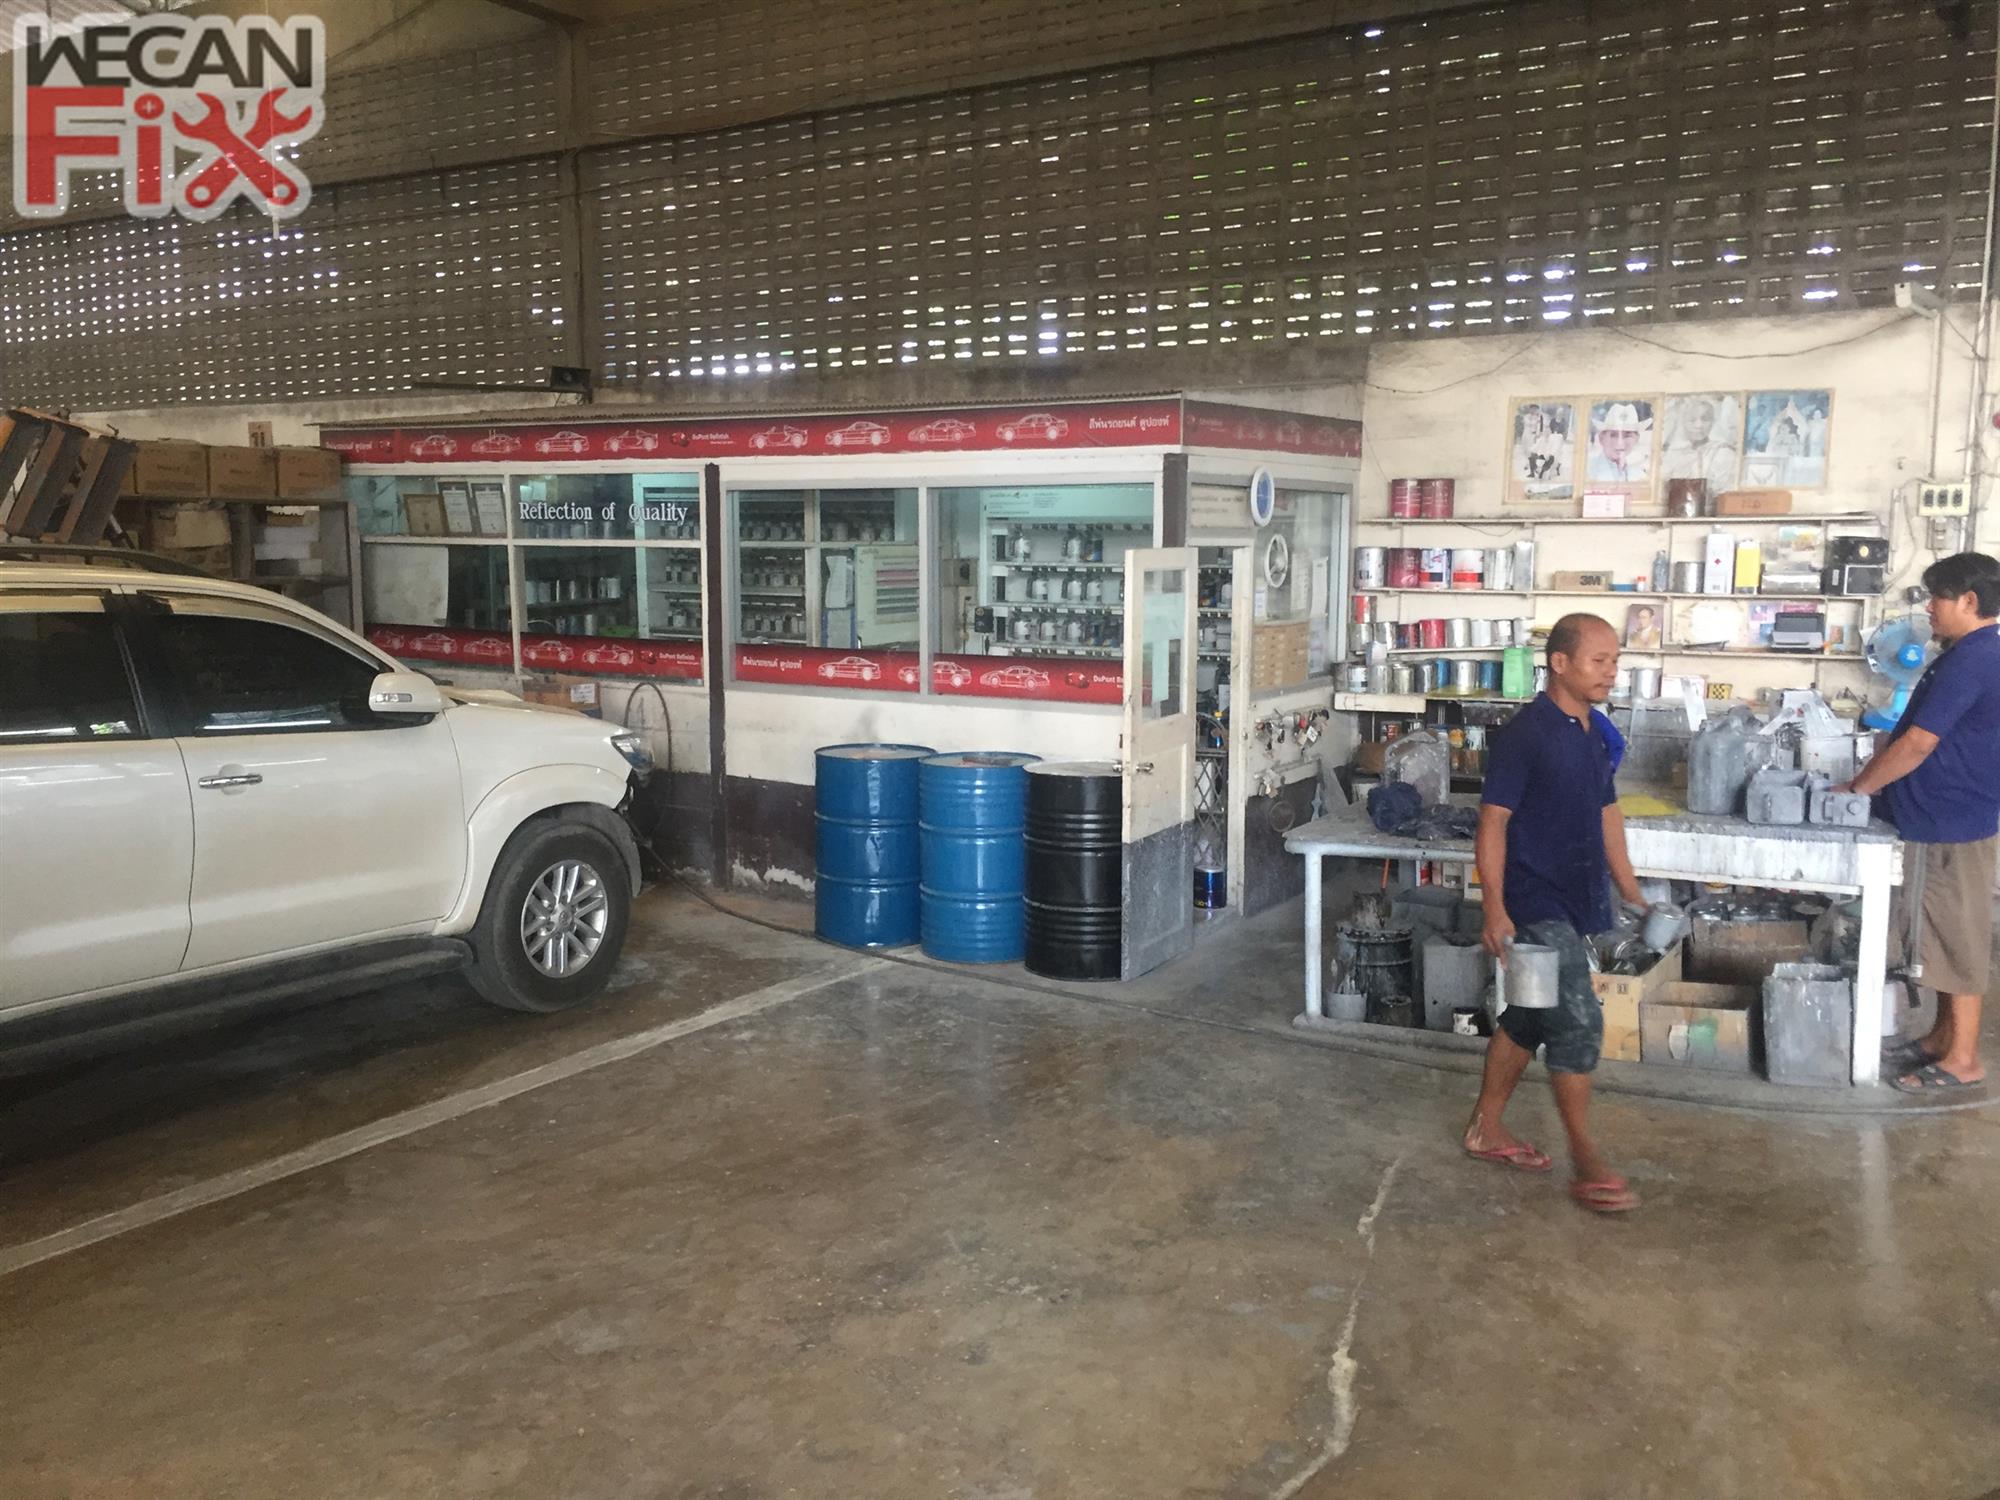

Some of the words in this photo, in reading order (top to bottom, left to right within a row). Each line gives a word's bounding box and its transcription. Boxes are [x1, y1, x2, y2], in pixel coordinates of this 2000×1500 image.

[519, 501, 593, 520] Reflection
[601, 501, 616, 520] of
[628, 502, 688, 525] Quality
[1579, 575, 1601, 586] 3M
[1093, 675, 1116, 683] DuPont
